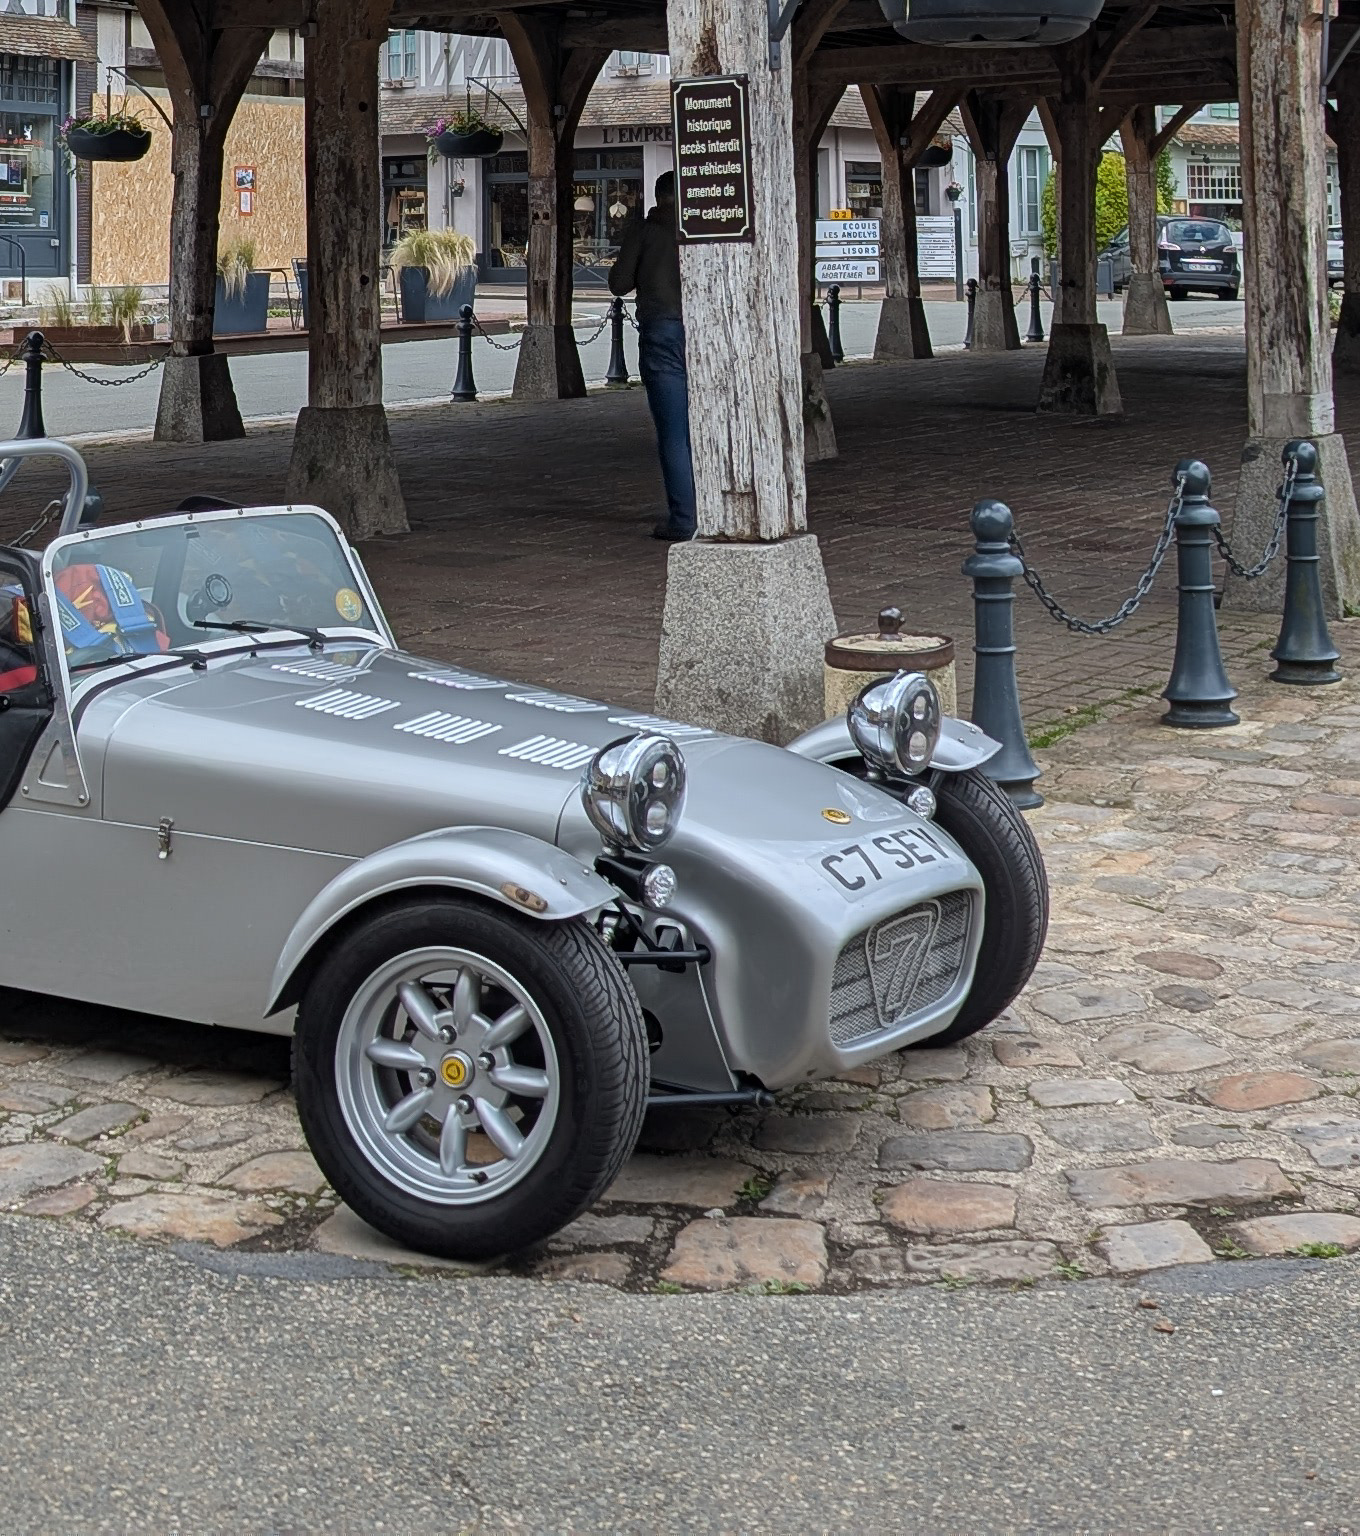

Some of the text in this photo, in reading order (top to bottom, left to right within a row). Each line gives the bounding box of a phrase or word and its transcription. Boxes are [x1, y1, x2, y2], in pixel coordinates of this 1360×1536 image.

[685, 96, 732, 111] Monument
[686, 117, 732, 133] historique
[681, 138, 741, 155] accès interdit
[681, 161, 742, 177] aux véhicules
[686, 183, 736, 199] amende de
[683, 205, 744, 223] 5ème catégorie
[824, 231, 878, 239] LES ANDELYS
[843, 247, 877, 255] LISORS
[822, 263, 851, 271] ABBAYE
[822, 271, 863, 280] MORTEMER
[821, 828, 949, 891] C7 SEV
[874, 911, 933, 1013] 7
